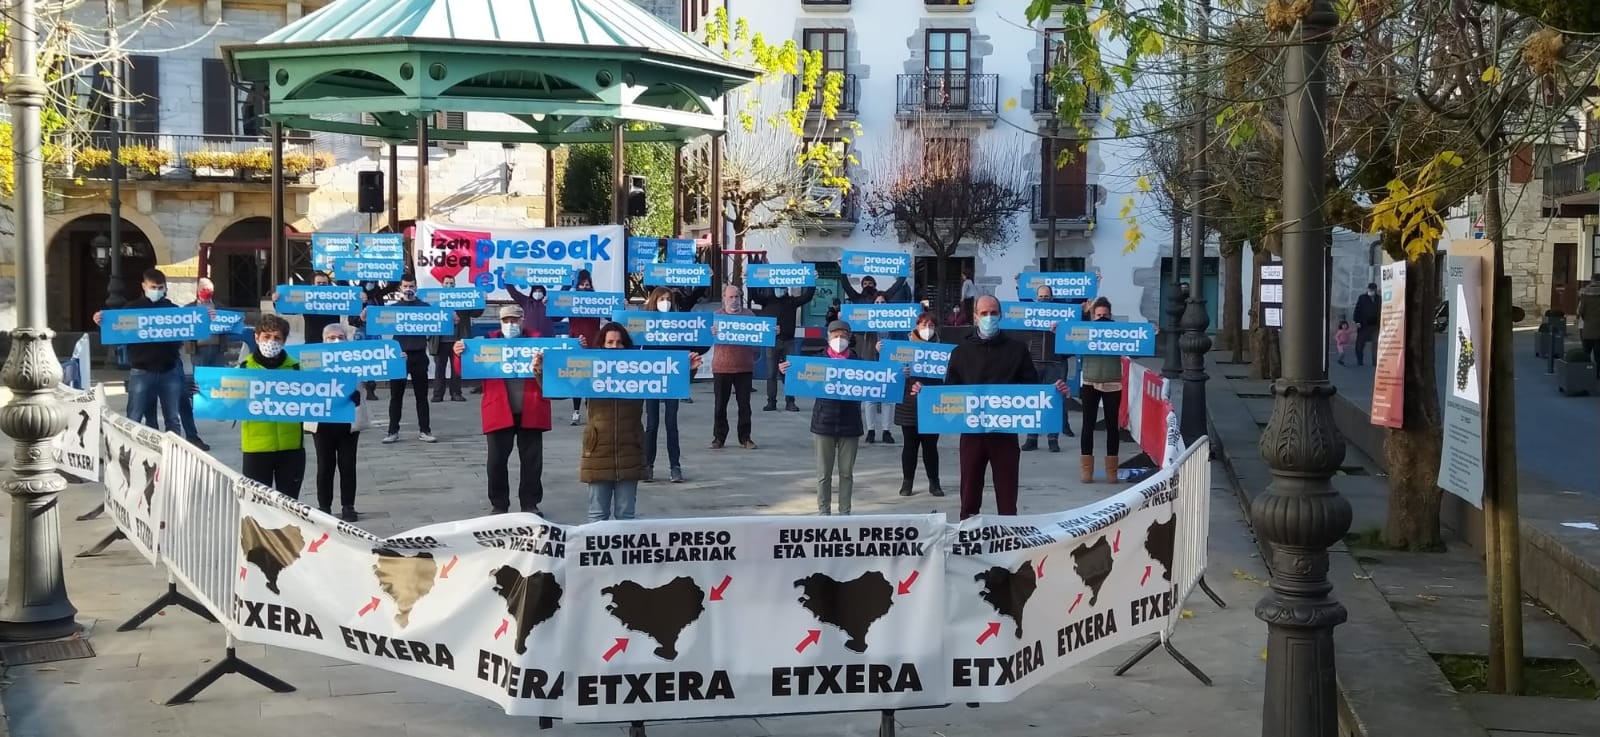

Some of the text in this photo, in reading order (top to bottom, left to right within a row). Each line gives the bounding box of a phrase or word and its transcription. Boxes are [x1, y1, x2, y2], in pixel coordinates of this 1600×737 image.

[431, 233, 471, 250] izan
[475, 234, 612, 268] presoak
[417, 249, 472, 268] bidea
[863, 254, 905, 265] presoak
[357, 261, 399, 271] presoak
[526, 266, 568, 277] presoak
[665, 266, 706, 277] presoak
[769, 267, 811, 277] presoak
[863, 264, 900, 274] etxera!
[357, 270, 393, 279] etxera!
[526, 275, 563, 284] etxera!
[665, 275, 701, 284] etxera!
[769, 275, 806, 285] etxera!
[1044, 276, 1092, 288] presoak
[304, 289, 357, 302] presoak
[439, 290, 481, 302] presoak
[1050, 286, 1086, 296] txera!
[304, 301, 350, 311] etxera!
[439, 299, 476, 308] etxera!
[571, 295, 619, 307] presoak
[395, 310, 449, 322] presoak
[571, 305, 614, 315] etxera!
[868, 307, 918, 320] presoak
[1023, 306, 1076, 319] presoak
[138, 311, 203, 326] presoak
[645, 316, 707, 332] presoak
[868, 318, 911, 328] etxera!
[138, 324, 195, 339] etxera!
[395, 321, 442, 333] etxera!
[717, 319, 770, 334] presoak
[1087, 326, 1149, 341] presoak
[645, 329, 699, 342] etxera!
[716, 331, 763, 343] etxera!
[1087, 339, 1141, 353] etxera!
[322, 344, 397, 364] presoak
[914, 349, 952, 362] pres
[592, 356, 680, 377] presoak
[913, 361, 947, 375] etxe
[825, 366, 898, 384] presoak
[249, 377, 345, 399] presoak
[592, 375, 668, 394] etxera!
[824, 381, 887, 398] etxera!
[248, 398, 332, 417] etxera!
[965, 390, 1054, 413] presoak
[965, 411, 1042, 429] etxera!
[585, 530, 732, 551] EUSKAL PRESO
[779, 526, 919, 544] EUSKAL PRESO
[958, 524, 1041, 543] EUSKAL PRESO
[773, 542, 925, 560] ETA IHESLARIAK
[952, 542, 983, 556] ETA
[579, 546, 737, 567] ETA IHESLARIAK
[1057, 608, 1118, 657] ETXERA
[339, 624, 455, 671] ETXERA
[952, 640, 1045, 687] ETXERA
[771, 662, 924, 697] ETXERA
[577, 670, 736, 706] ETXERA
